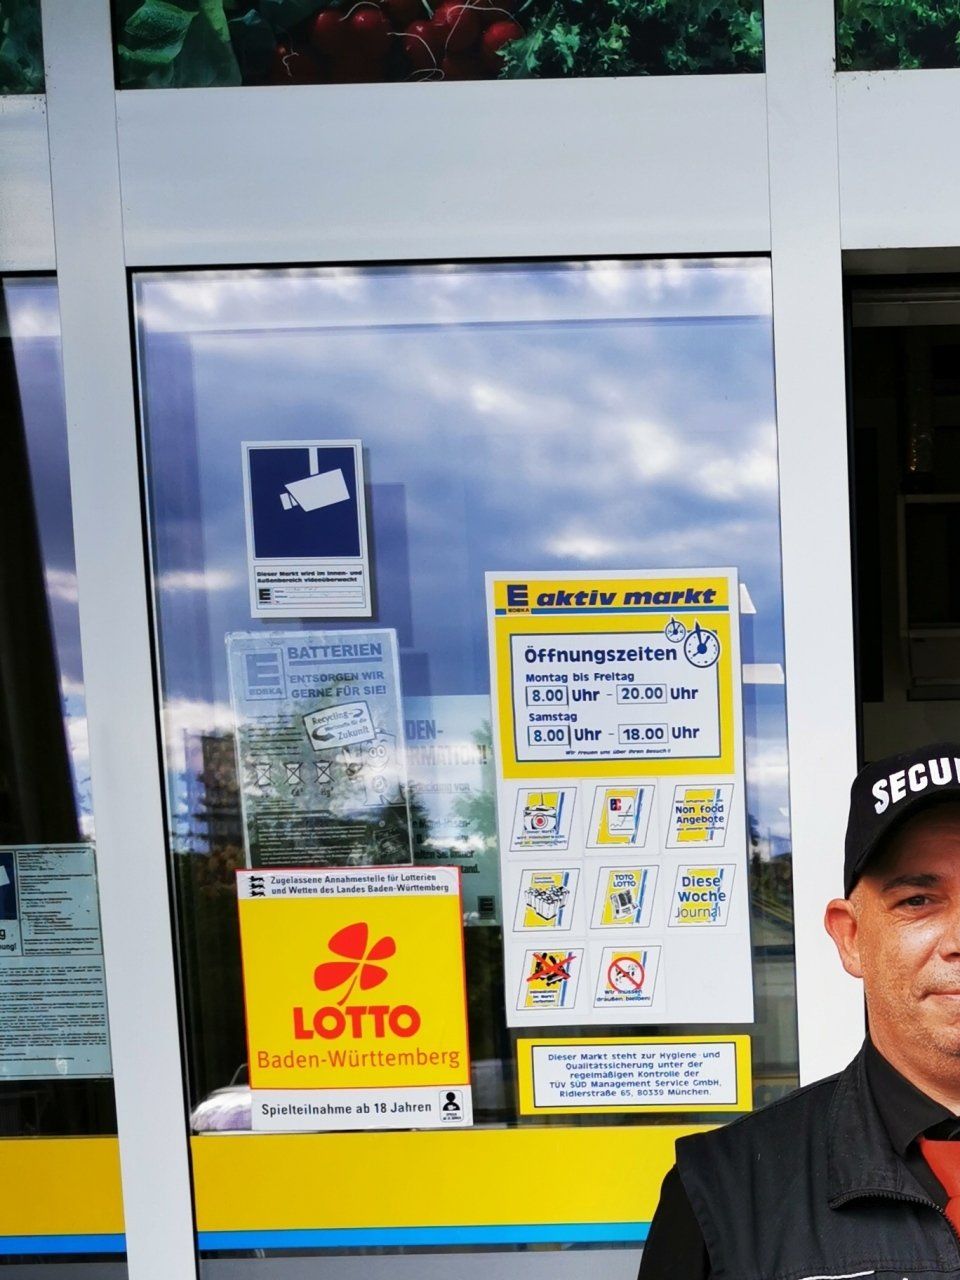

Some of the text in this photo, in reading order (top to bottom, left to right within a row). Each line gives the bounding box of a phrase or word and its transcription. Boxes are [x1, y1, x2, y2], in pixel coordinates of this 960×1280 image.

[537, 590, 617, 607] aktiv
[623, 588, 717, 606] markt
[287, 643, 382, 660] BATTERIEN
[525, 646, 678, 665] Öffnungszeiten
[289, 671, 384, 684] ENTSORGEN WIR
[526, 672, 635, 684] Montag bis Freitag
[291, 685, 387, 699] GERNE FÜR SIE!
[532, 687, 699, 702] 8.00 Uhr 20.00 Uhr
[529, 712, 578, 723] Samstag
[337, 726, 370, 741] Zukunft
[406, 720, 444, 739] DEN-
[533, 727, 700, 742] 8.00 Uhr 18.00 Uhr
[676, 805, 724, 814] Non food
[676, 816, 725, 825] Angebote
[270, 874, 436, 885] Zugelassene Annahmestelle für Lotterien
[613, 880, 637, 888] LOTTO
[682, 875, 721, 888] Diese
[272, 886, 287, 894] und
[291, 886, 318, 894] Wetten
[337, 885, 366, 893] Landes
[368, 883, 450, 894] Baden-Württemberg
[678, 890, 727, 902] Woche
[675, 906, 721, 919] Journal
[293, 1005, 421, 1040] LOTTO
[258, 1048, 460, 1069] Baden-Württemberg
[581, 1053, 608, 1061] Markt
[703, 1051, 721, 1059] und
[566, 1061, 654, 1071] Qualitätssicherung
[658, 1061, 684, 1069] unter
[570, 1070, 700, 1080] regelmäßigen Kontrolle der
[550, 1080, 566, 1089] TÜV
[570, 1080, 587, 1089] SÜD
[591, 1080, 651, 1089] Management
[655, 1079, 690, 1087] Service
[560, 1090, 617, 1098] Ridlerstraße
[637, 1089, 664, 1097] 80339
[262, 1102, 432, 1118] Spielteilnahme ab 18 Jahren
